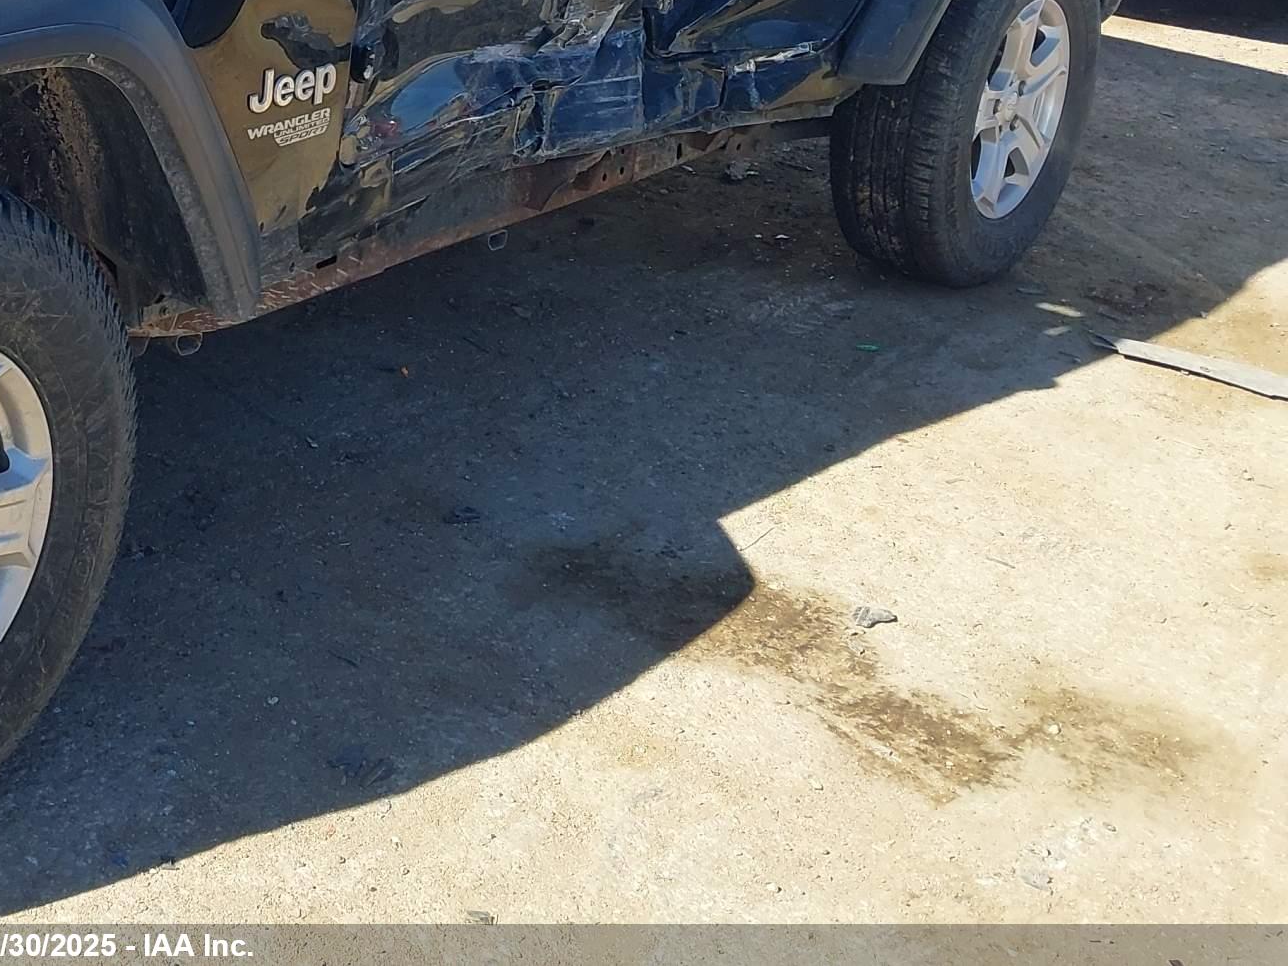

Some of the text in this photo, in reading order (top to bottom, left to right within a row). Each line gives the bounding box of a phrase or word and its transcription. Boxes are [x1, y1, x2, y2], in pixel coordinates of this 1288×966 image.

[248, 63, 338, 114] Jeep
[247, 107, 331, 140] WRANGLER
[274, 117, 331, 138] UNLIMITED
